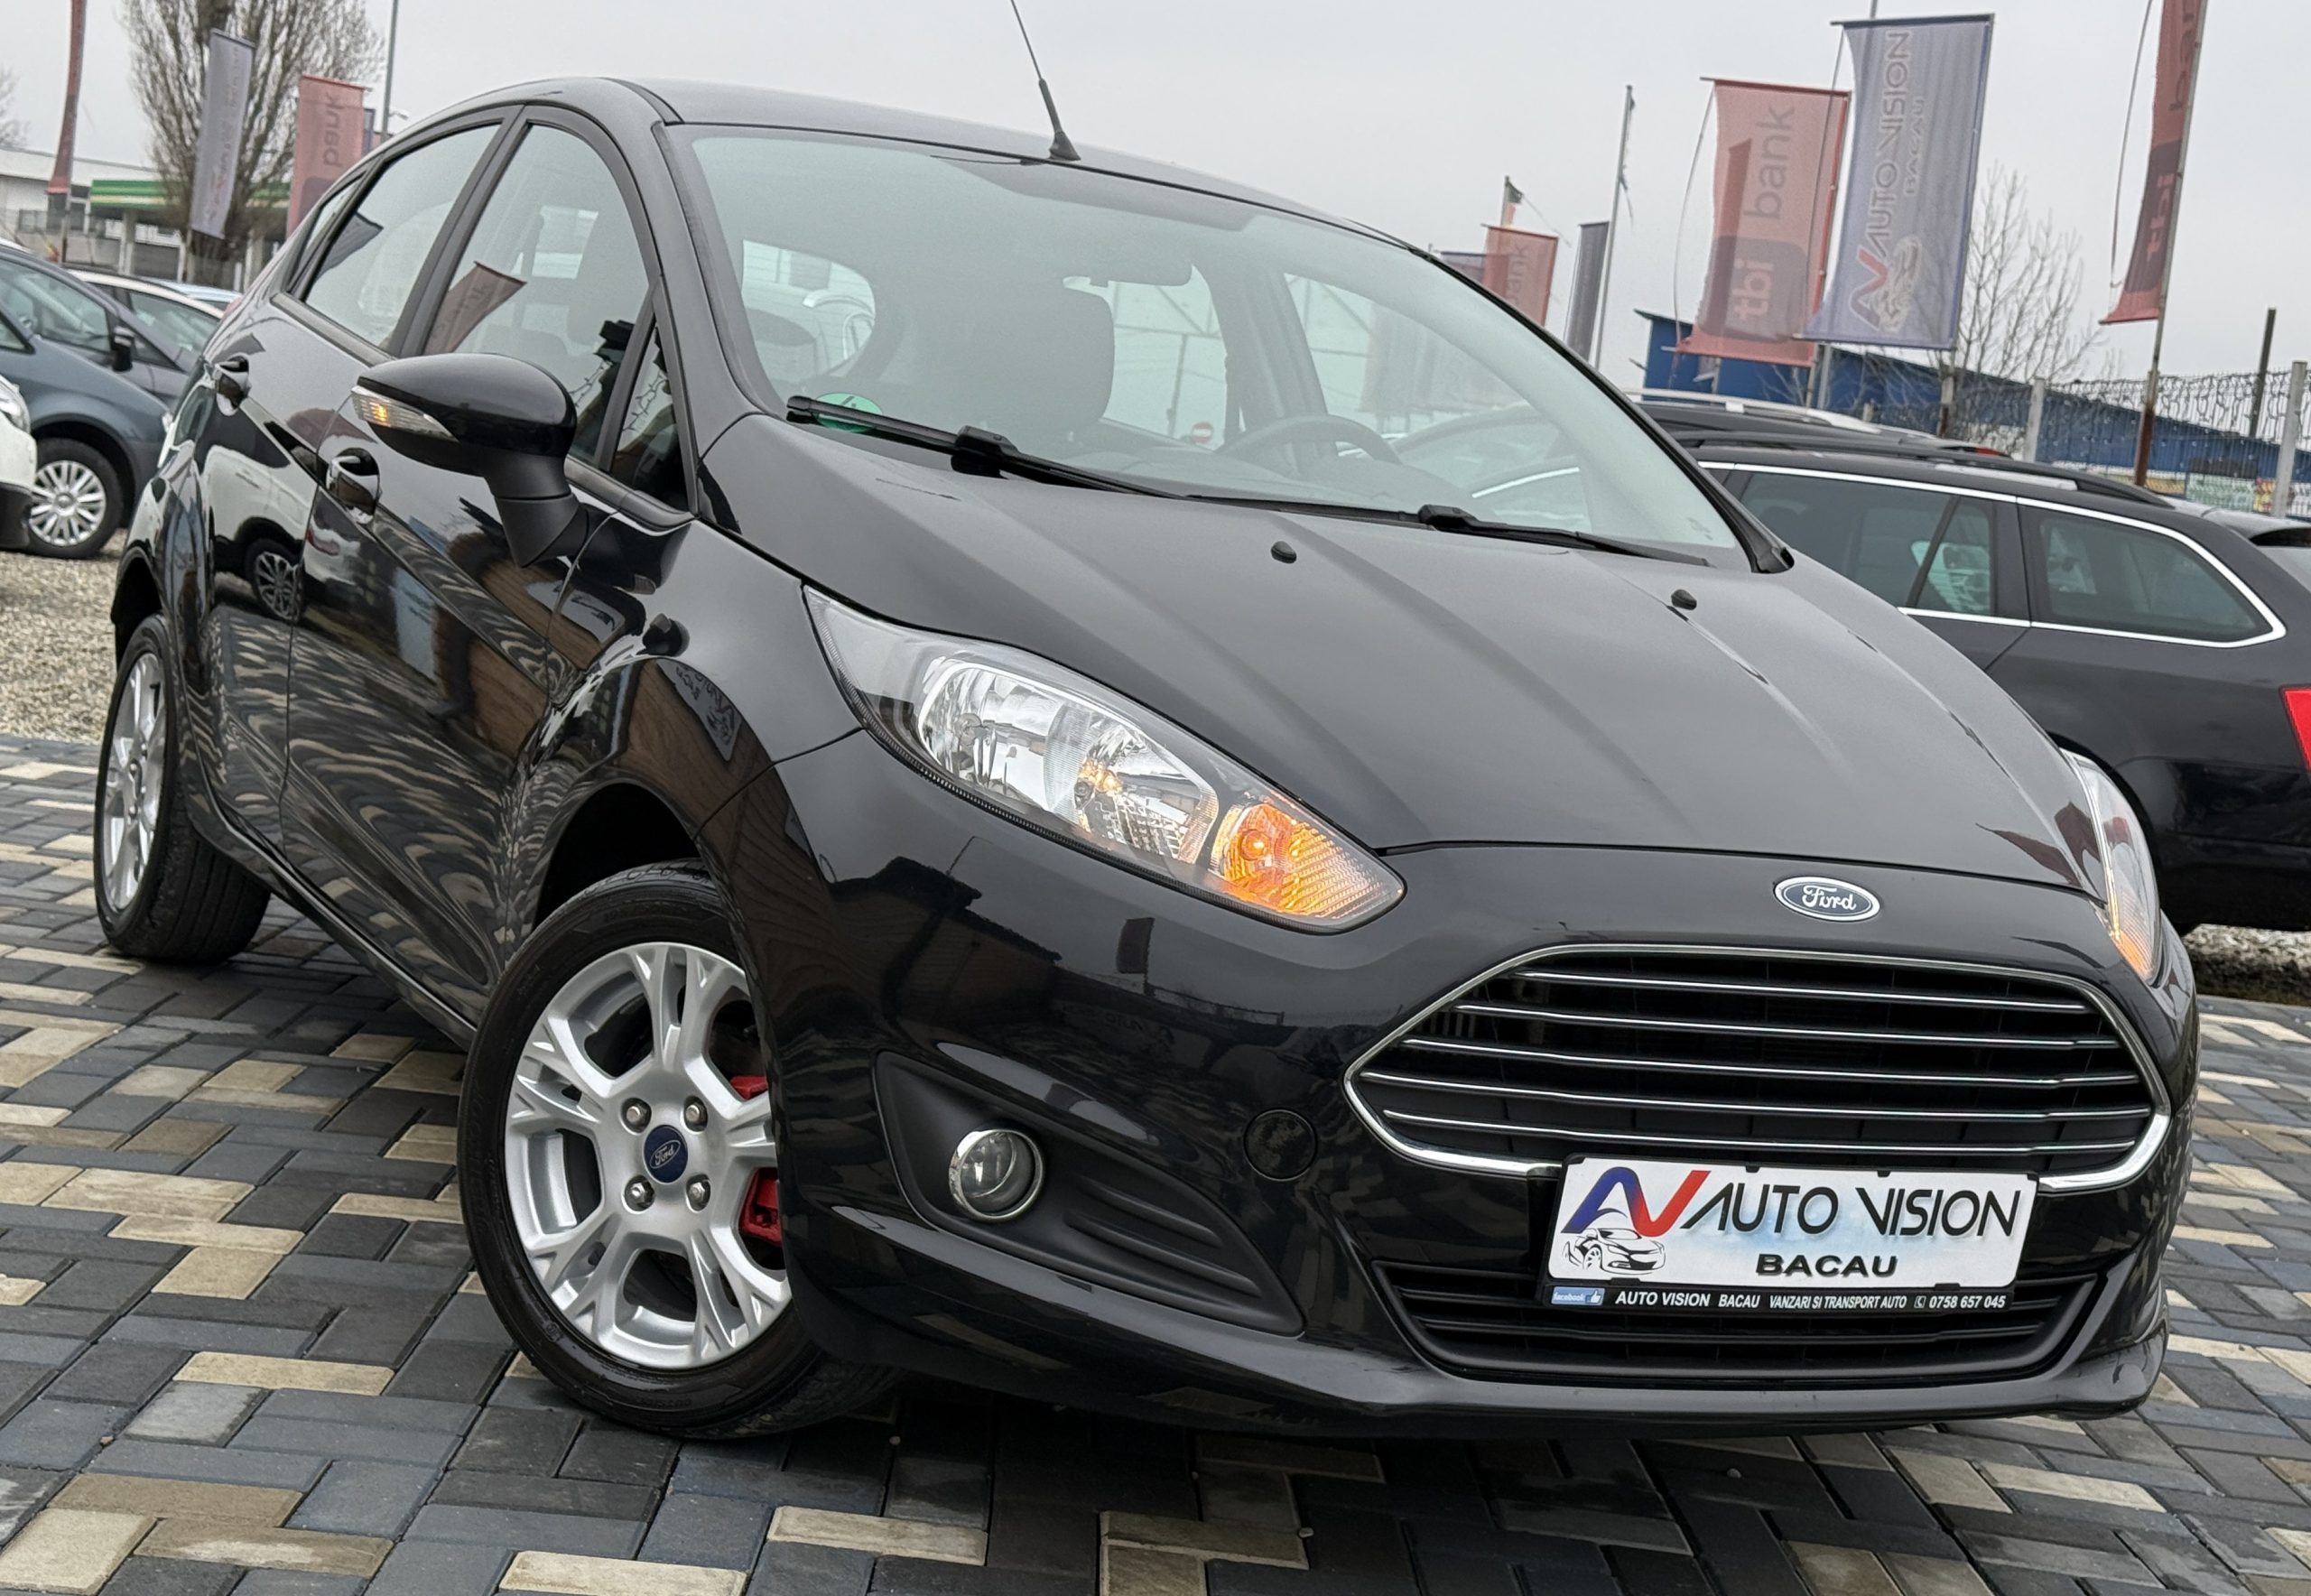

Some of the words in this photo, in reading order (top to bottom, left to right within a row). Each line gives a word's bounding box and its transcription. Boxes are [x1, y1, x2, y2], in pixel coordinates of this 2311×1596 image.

[1877, 31, 1911, 154] VISION
[1743, 106, 1795, 219] bank
[1866, 162, 1898, 257] AUTO
[1731, 257, 1775, 320] tbi
[1802, 885, 1857, 911] Ford
[654, 1145, 675, 1165] Ford
[1680, 1183, 1839, 1234] AUTO
[1855, 1186, 2022, 1237] VISION
[1756, 1253, 1898, 1277] BACAU
[1554, 1291, 1586, 1302] facebook
[1615, 1291, 1658, 1305] AUTO
[1662, 1292, 1712, 1307] VISION
[1718, 1294, 1760, 1308] BACAU
[1768, 1294, 1812, 1309] VANZARI
[1812, 1295, 1823, 1309] SI
[1824, 1295, 1881, 1309] TRANSPORT
[1879, 1295, 1907, 1309] AUTO
[1928, 1295, 1959, 1309] 0758
[1960, 1295, 1982, 1309] 657
[1983, 1295, 2007, 1309] 045
